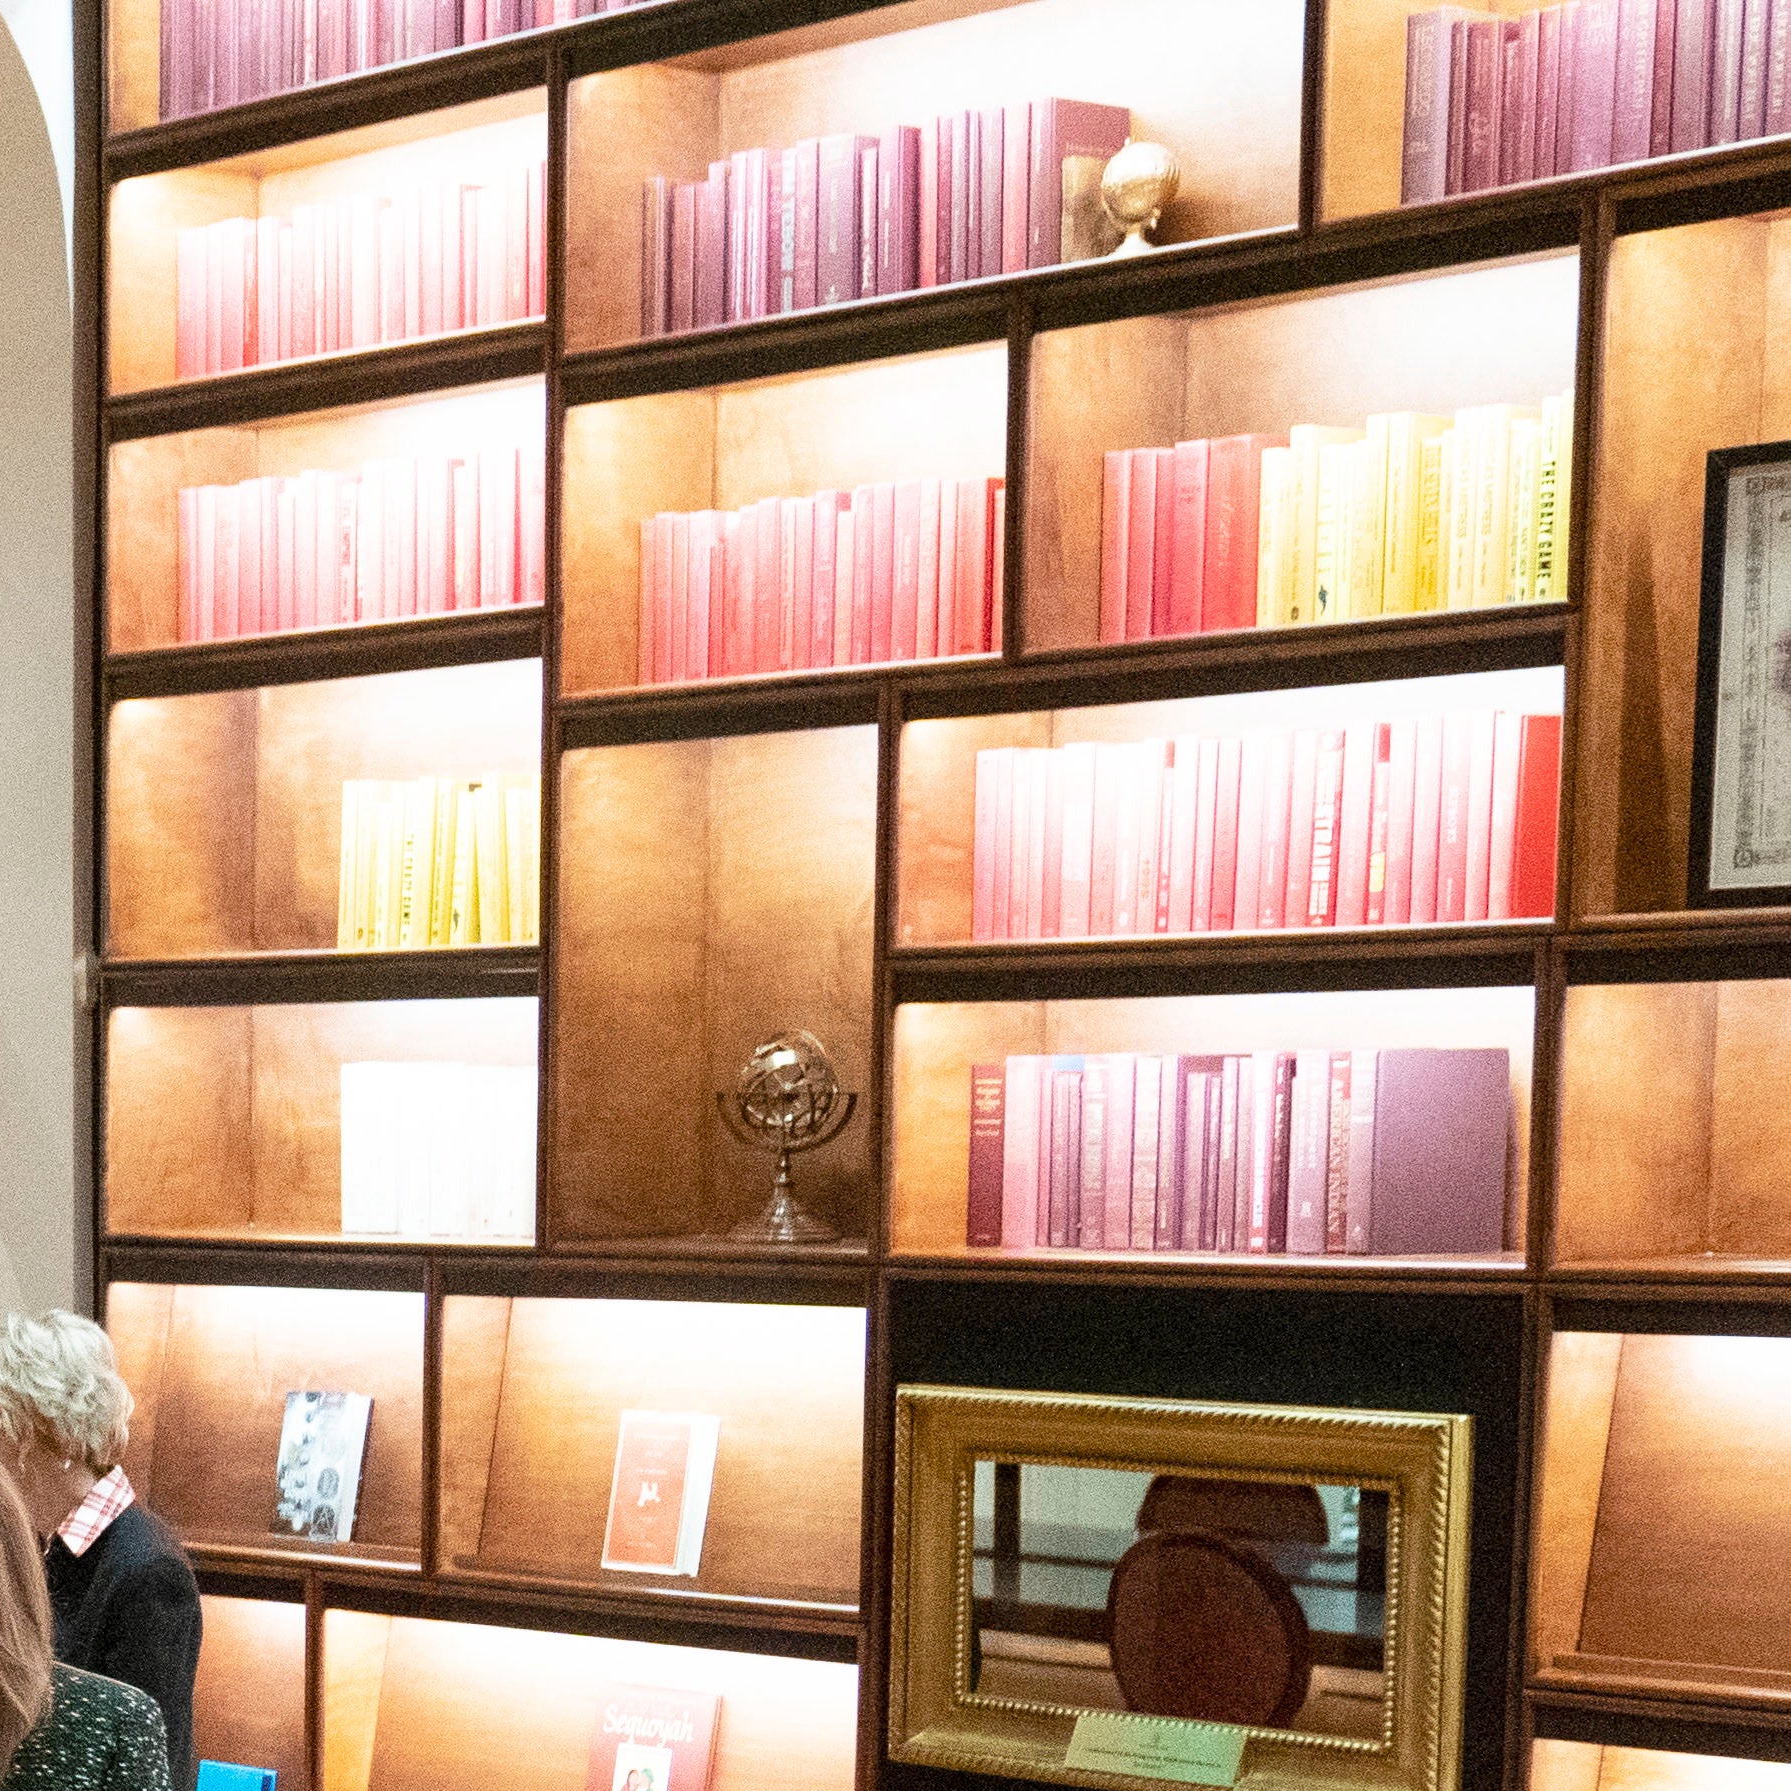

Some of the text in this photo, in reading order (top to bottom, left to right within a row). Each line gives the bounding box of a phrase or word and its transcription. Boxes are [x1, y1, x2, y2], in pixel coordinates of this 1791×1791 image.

[1539, 490, 1555, 534] CRAZY
[1536, 539, 1553, 579] GAME
[602, 1703, 695, 1748] Sequoyah
